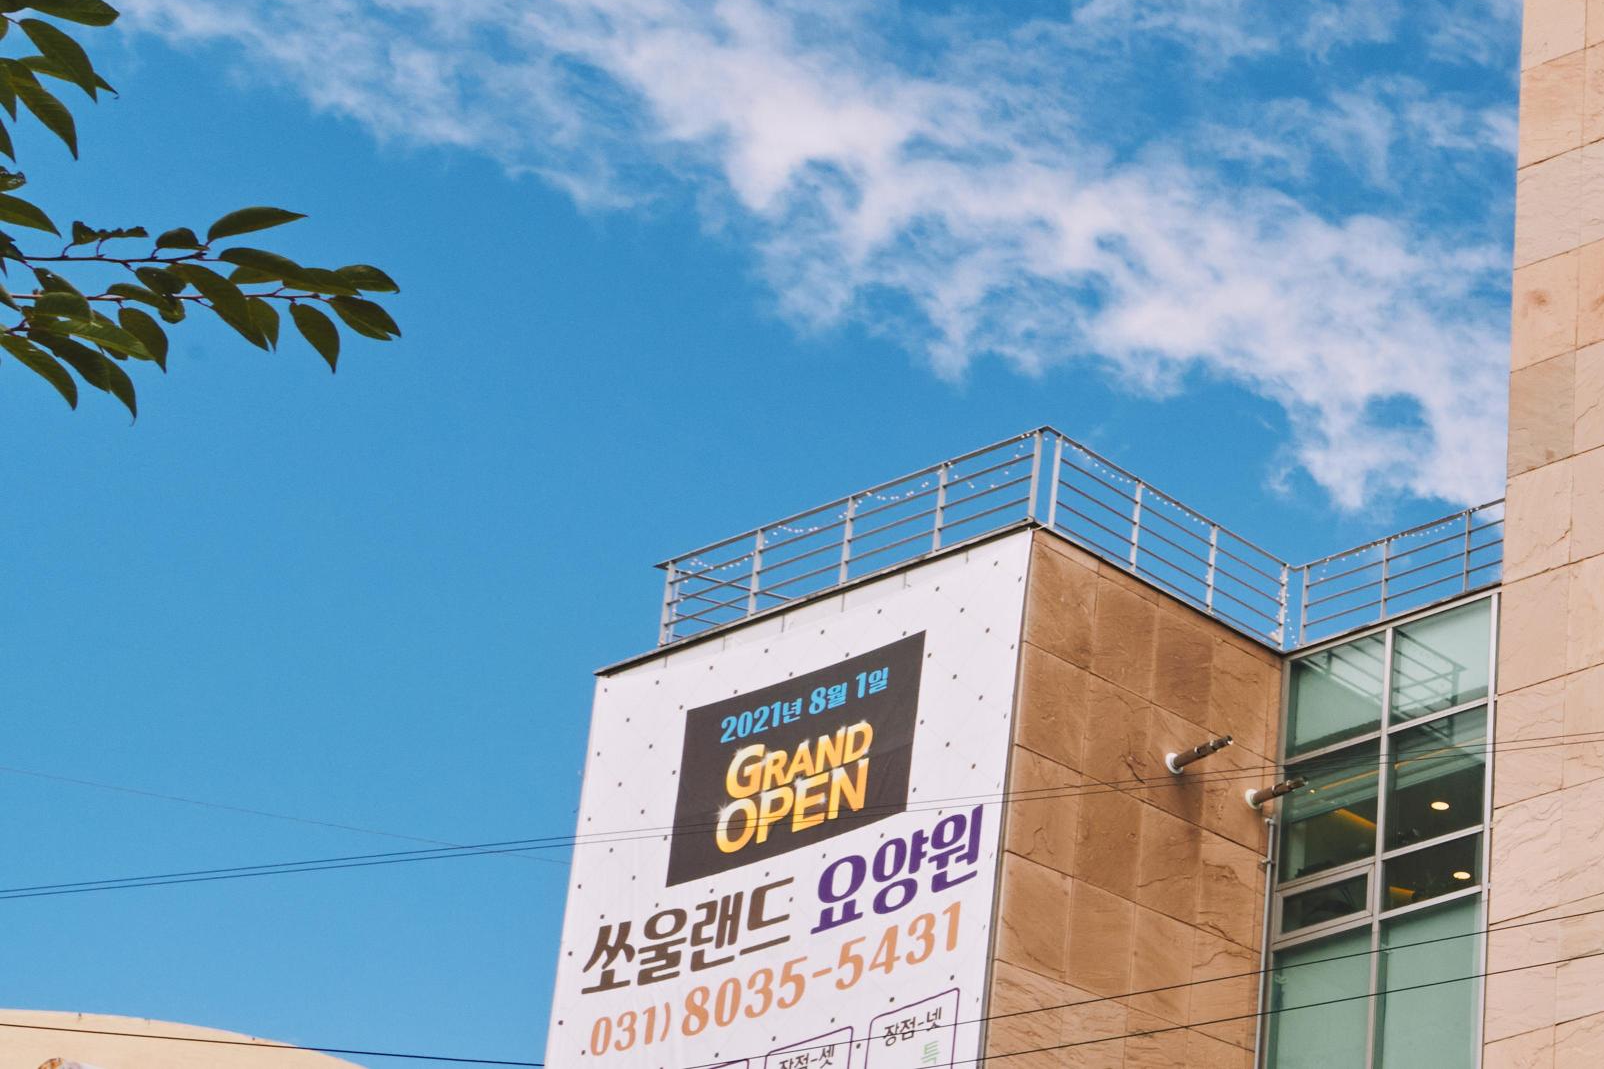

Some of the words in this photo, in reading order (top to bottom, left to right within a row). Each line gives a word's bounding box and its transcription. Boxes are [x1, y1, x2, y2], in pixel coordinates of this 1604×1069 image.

[720, 697, 803, 743] 2021년
[808, 682, 848, 715] 8월
[856, 667, 889, 698] 1일
[726, 721, 873, 799] GRAND
[716, 758, 869, 853] OPEN
[581, 877, 795, 995] 쏘울랜드
[810, 805, 983, 935] 요양원
